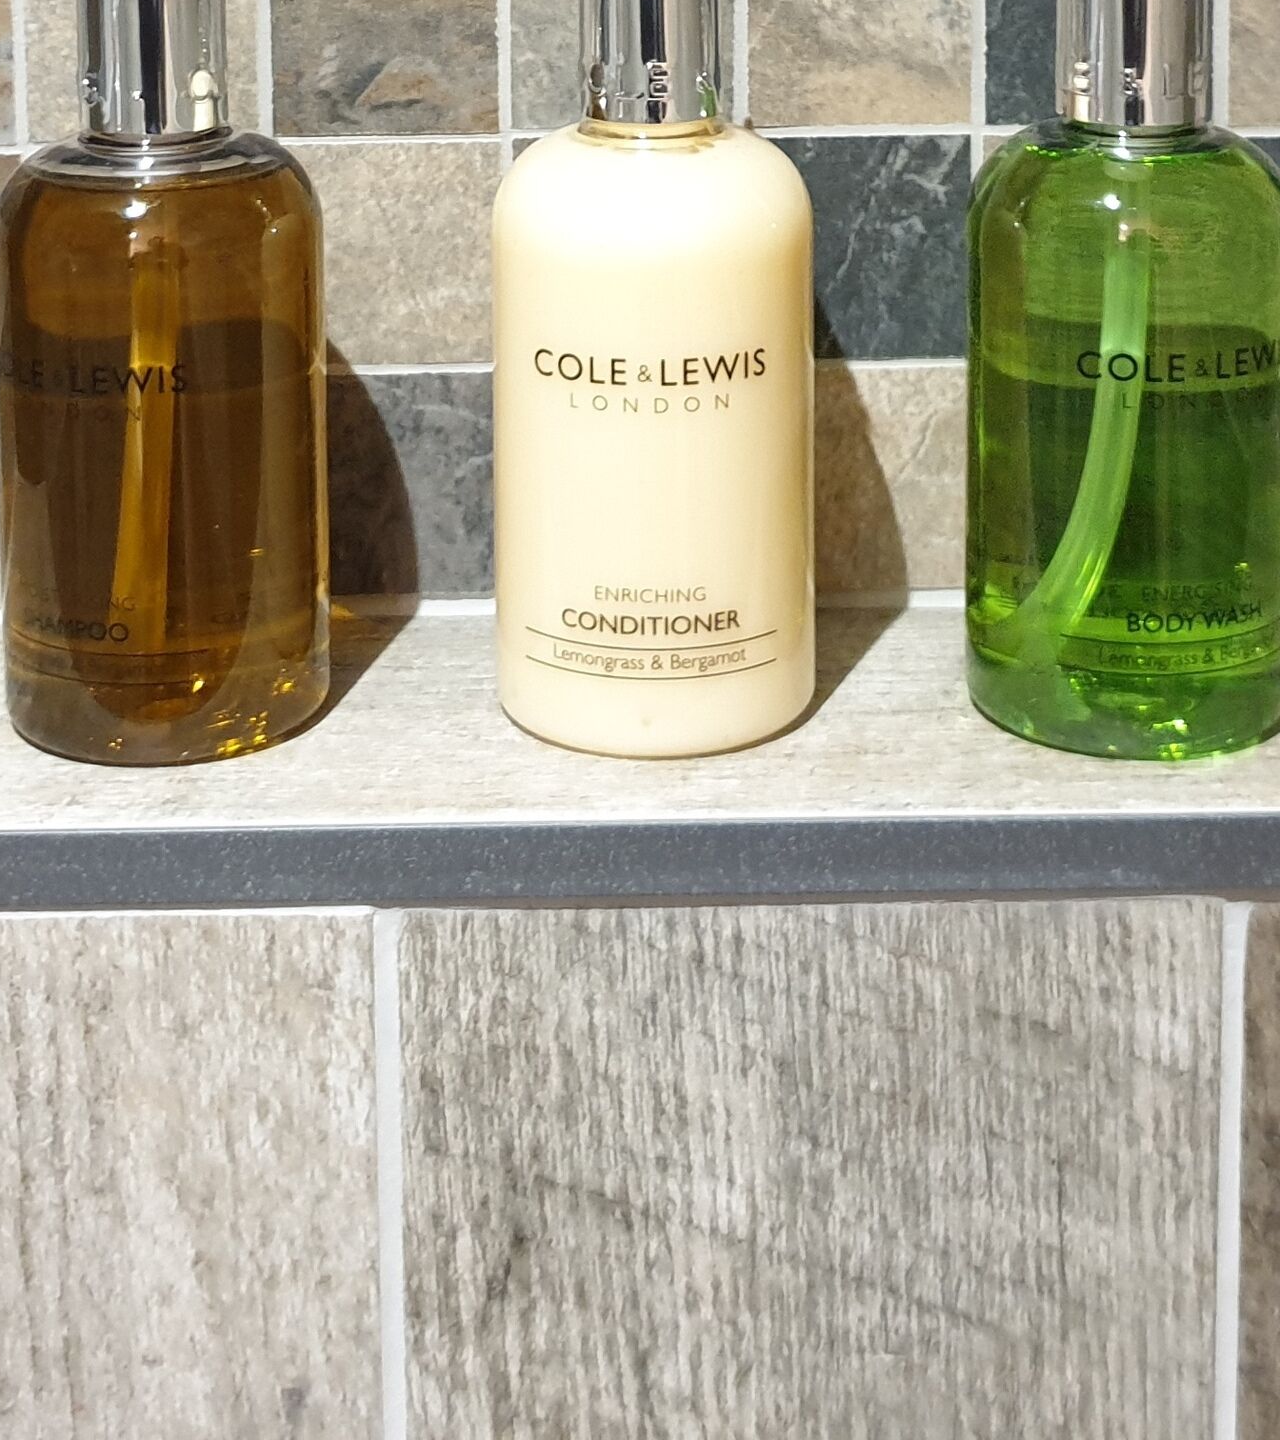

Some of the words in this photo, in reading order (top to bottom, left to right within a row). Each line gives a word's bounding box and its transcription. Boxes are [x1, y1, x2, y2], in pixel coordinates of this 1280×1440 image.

[68, 364, 188, 394] LEWIS
[534, 348, 627, 386] COLE
[636, 364, 653, 384] &
[660, 347, 767, 387] LEWIS
[1076, 350, 1186, 383] COLE
[1195, 358, 1210, 377] &
[570, 392, 730, 414] LONDON
[593, 585, 707, 604] ENRICHING
[561, 608, 741, 636] CONDITIONER
[1126, 613, 1195, 633] BODY
[1202, 600, 1263, 630] WASH
[553, 643, 645, 672] Lemongrass
[651, 655, 664, 670] &
[670, 647, 747, 672] Bergamot
